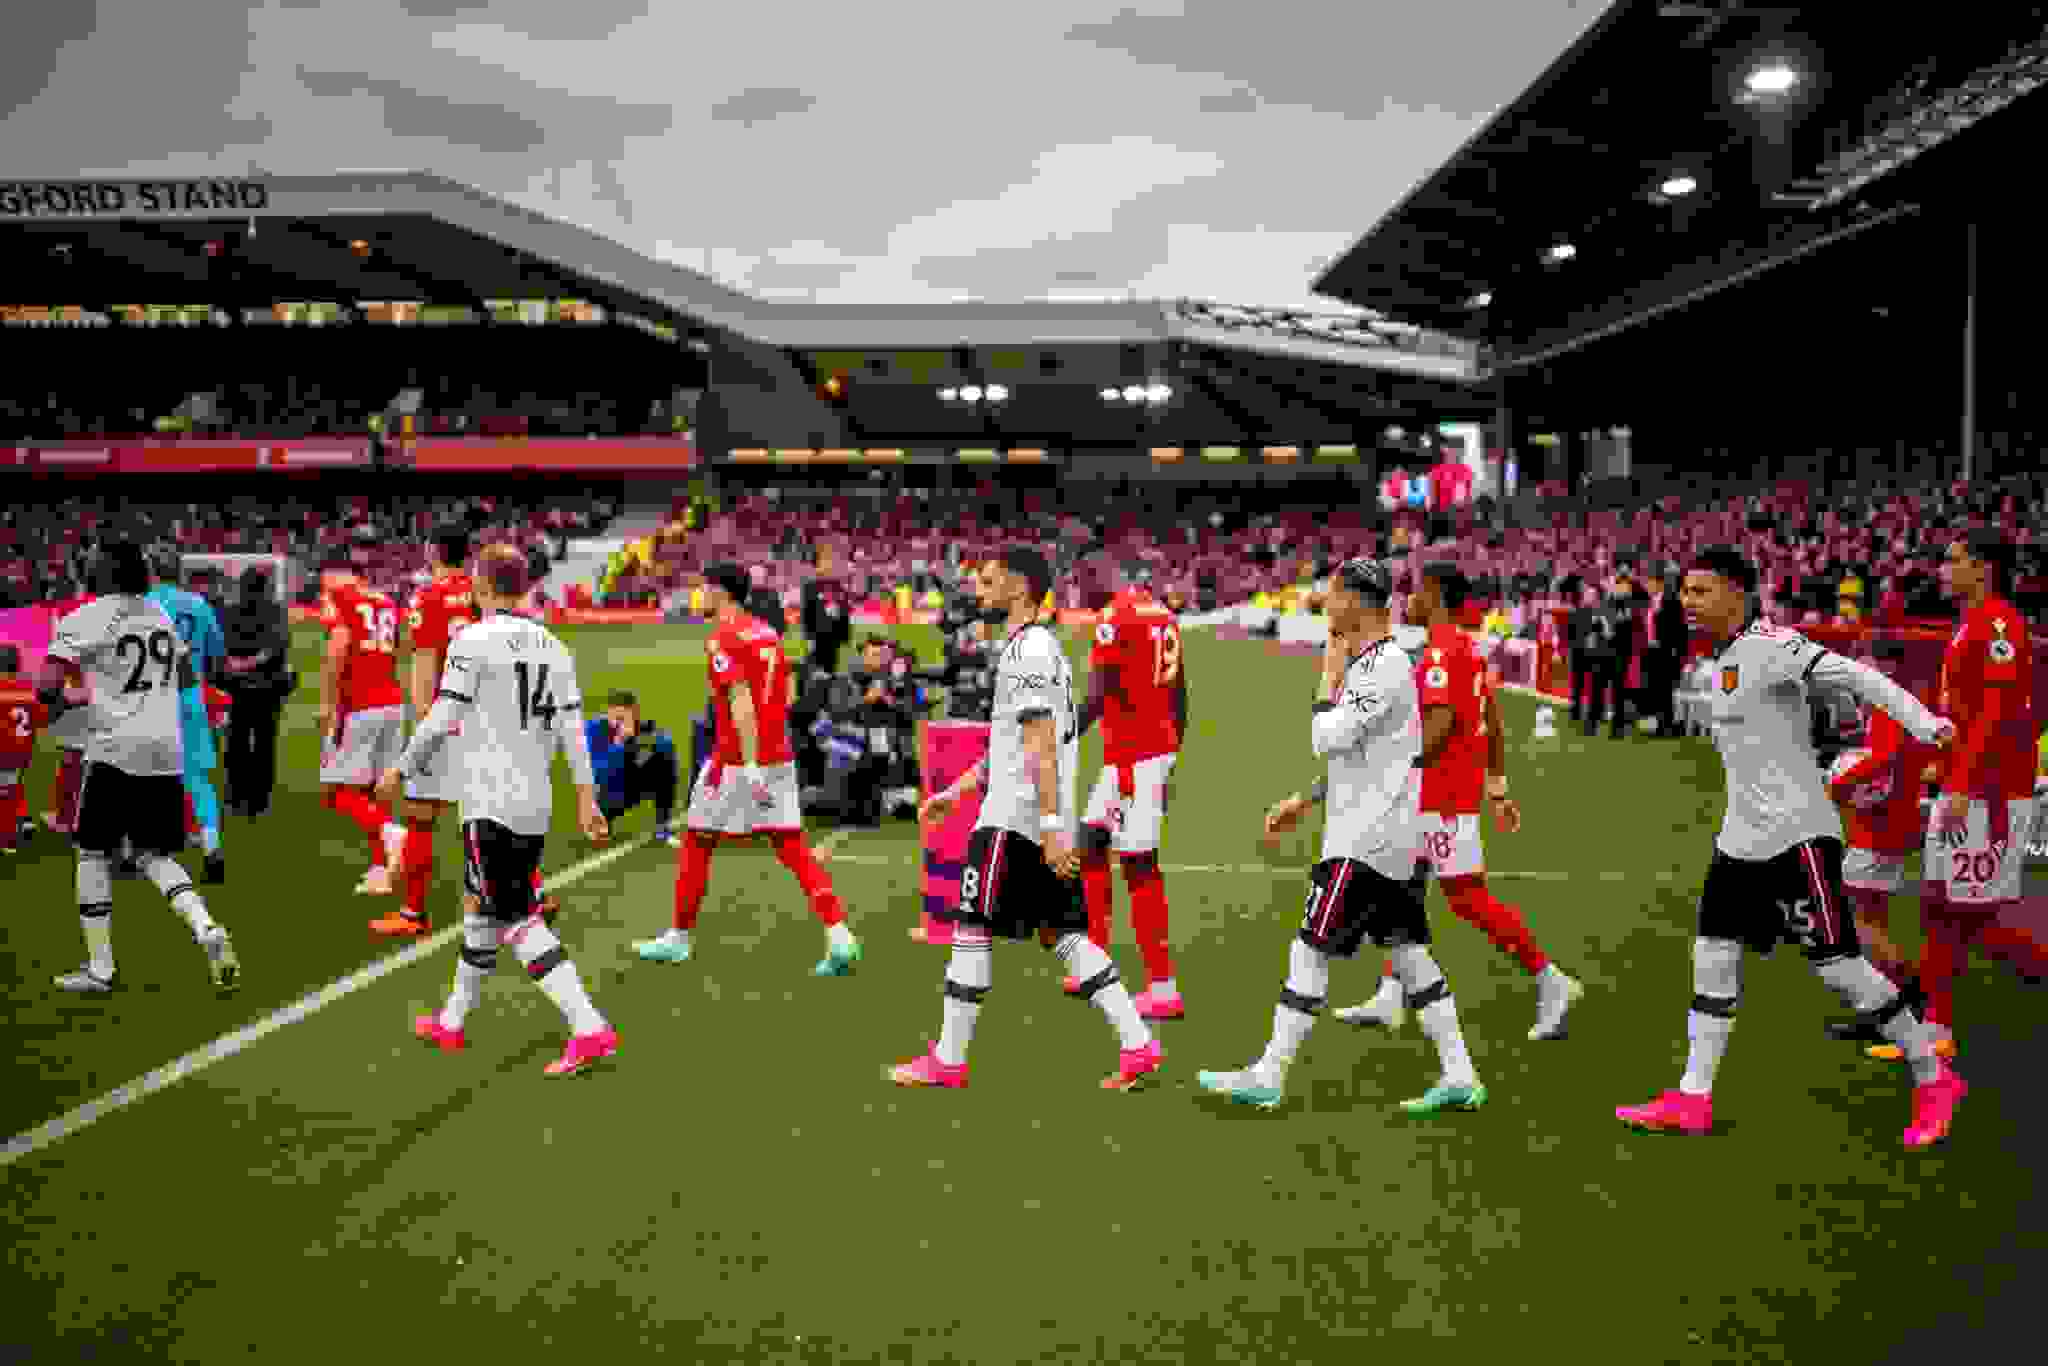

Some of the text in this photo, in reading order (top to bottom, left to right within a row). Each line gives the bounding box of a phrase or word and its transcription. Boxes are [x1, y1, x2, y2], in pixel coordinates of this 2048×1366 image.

[136, 183, 267, 209] STAND
[117, 634, 173, 692] 29
[514, 661, 555, 730] 14
[961, 866, 979, 899] 8
[1952, 852, 1995, 881] 20
